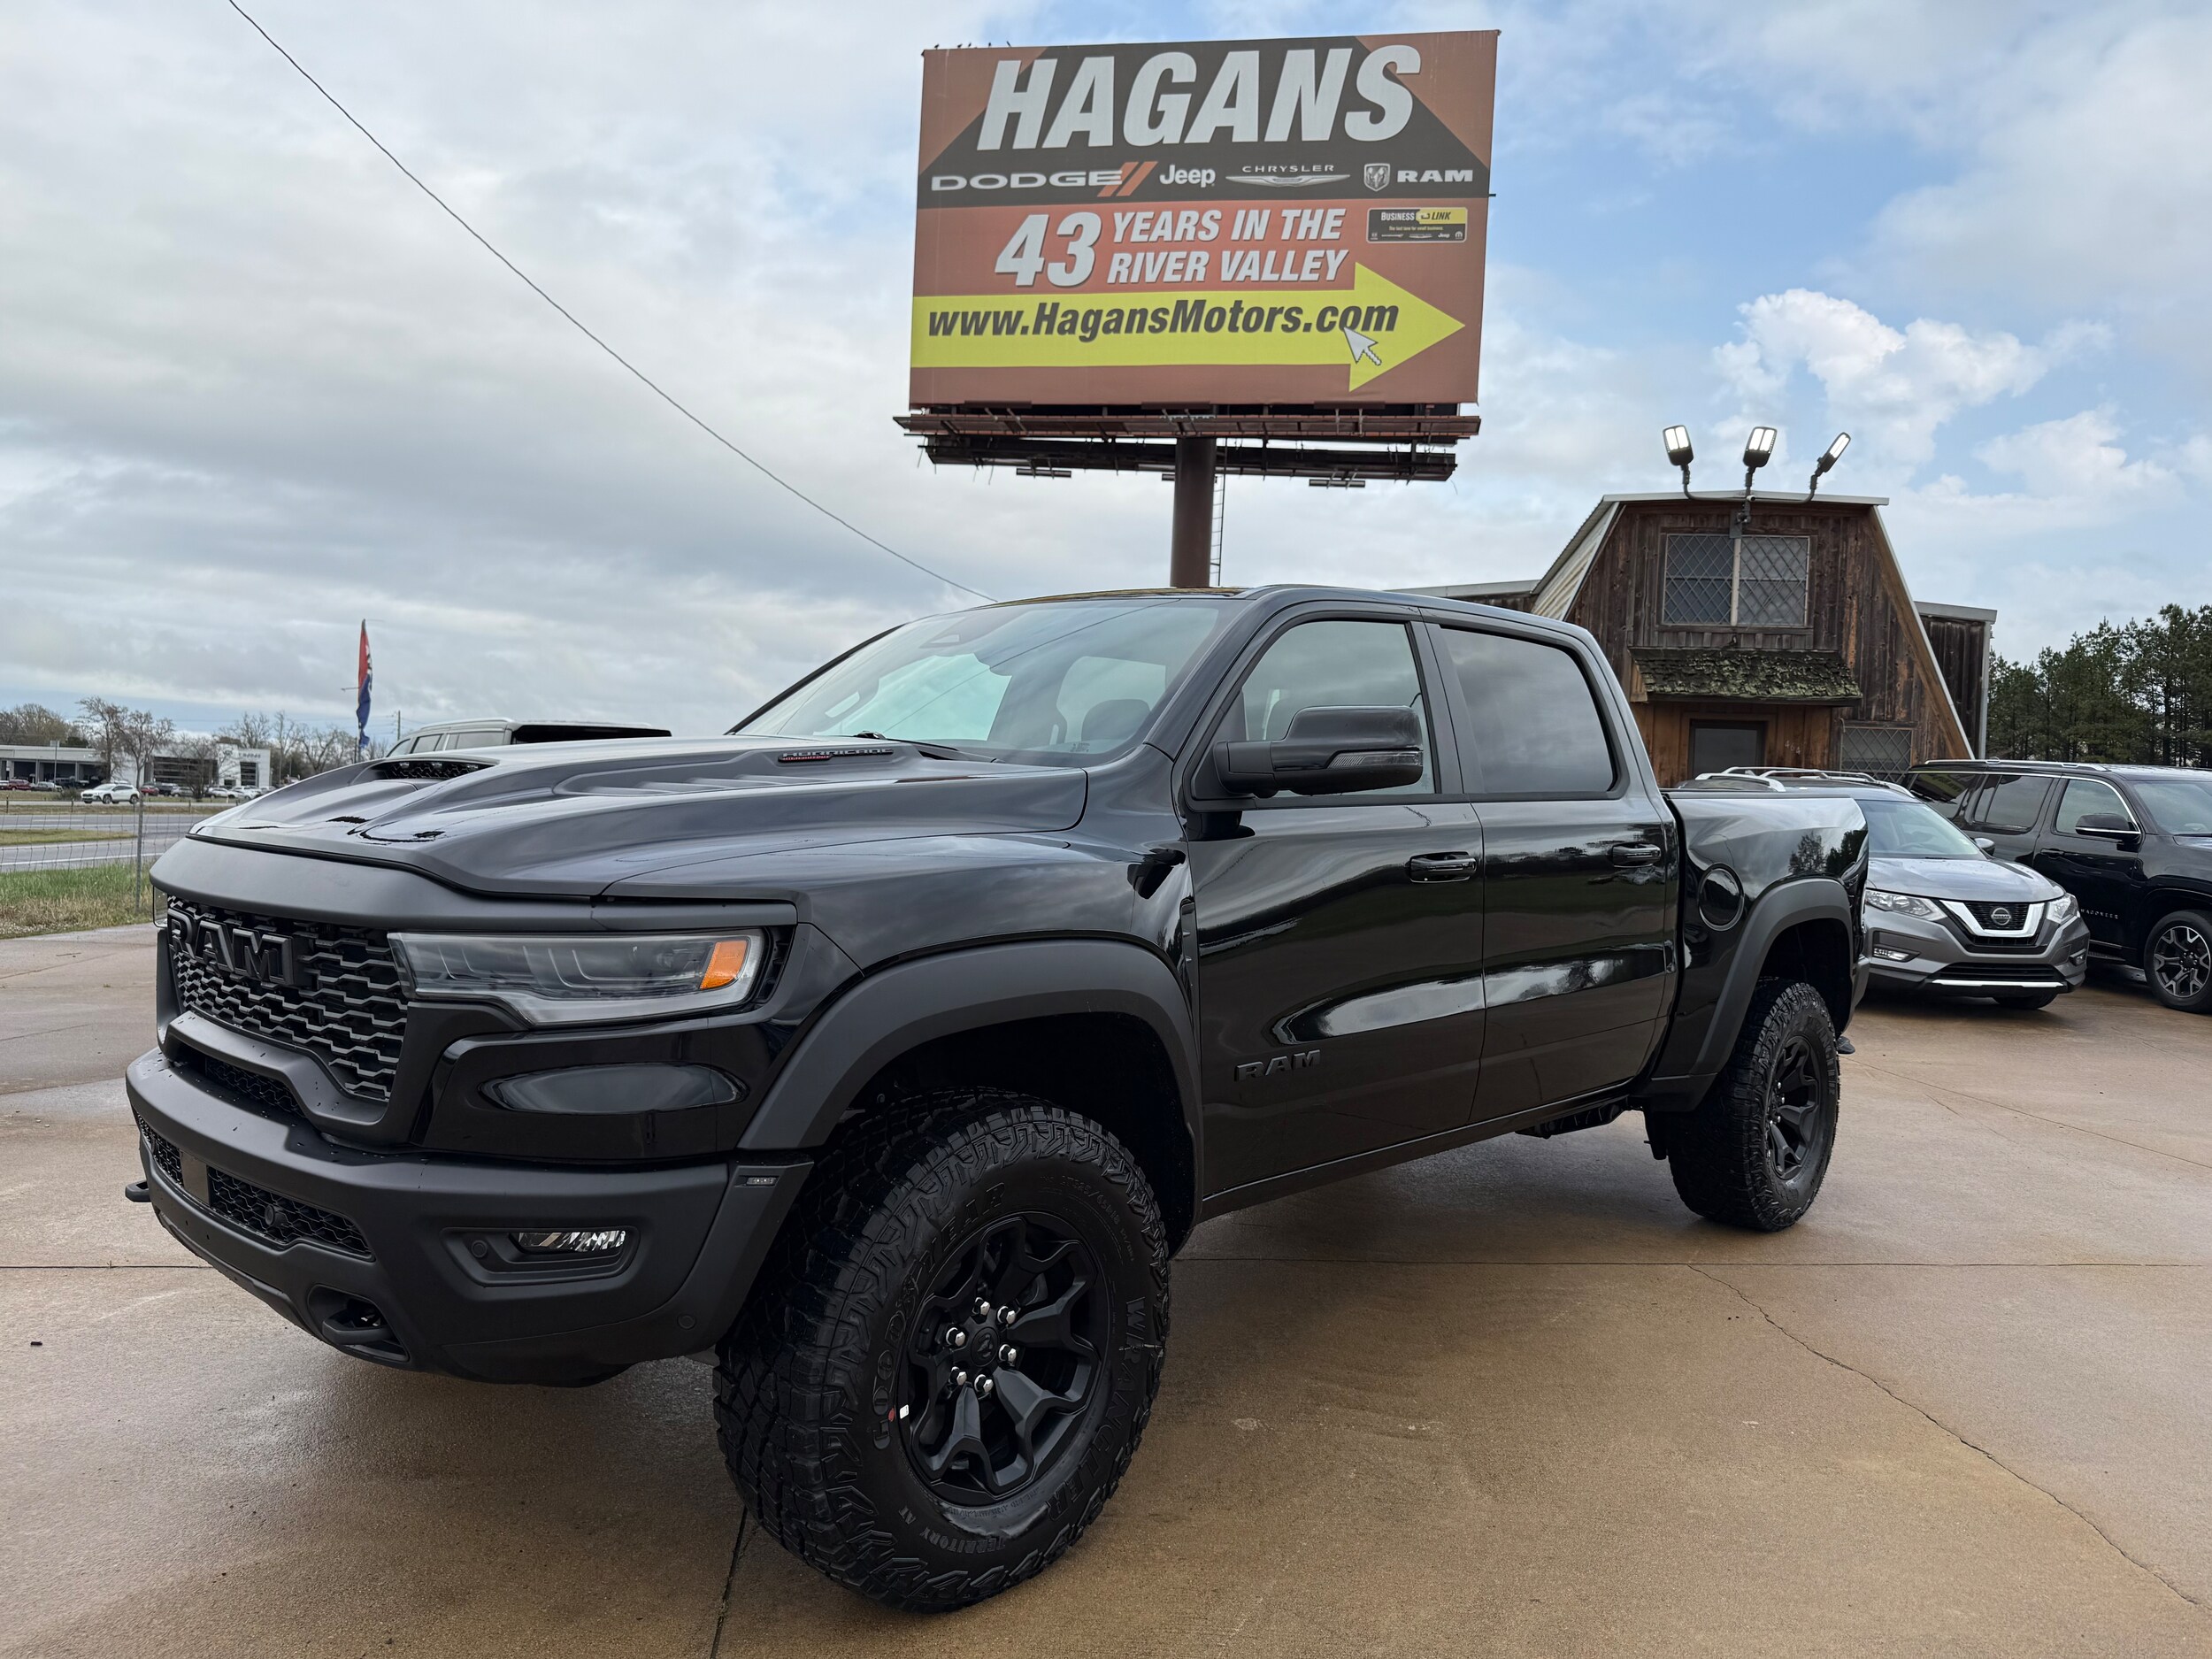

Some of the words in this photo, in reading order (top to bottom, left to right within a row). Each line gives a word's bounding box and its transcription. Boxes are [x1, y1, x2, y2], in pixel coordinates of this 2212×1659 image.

[977, 44, 1422, 151] HAGANS
[932, 170, 1123, 190] DODGE
[1159, 165, 1216, 188] Jeep
[1397, 170, 1473, 183] RAM
[1111, 210, 1222, 243] YEARS
[1231, 209, 1271, 242] IN
[1279, 208, 1347, 241] THE
[1381, 212, 1415, 221] BUSINESS
[1431, 211, 1451, 220] LINK
[994, 212, 1102, 288] 43
[1107, 250, 1210, 284] RIVER
[1219, 249, 1348, 282] VALLEY
[928, 298, 1400, 343] www.HagansMotors.com
[782, 748, 894, 757] HURRICANE
[168, 908, 294, 986] RAM
[1234, 1048, 1321, 1080] RAM
[1047, 1295, 1147, 1522] WRANGLER
[919, 1525, 1006, 1554] TERRITORY
